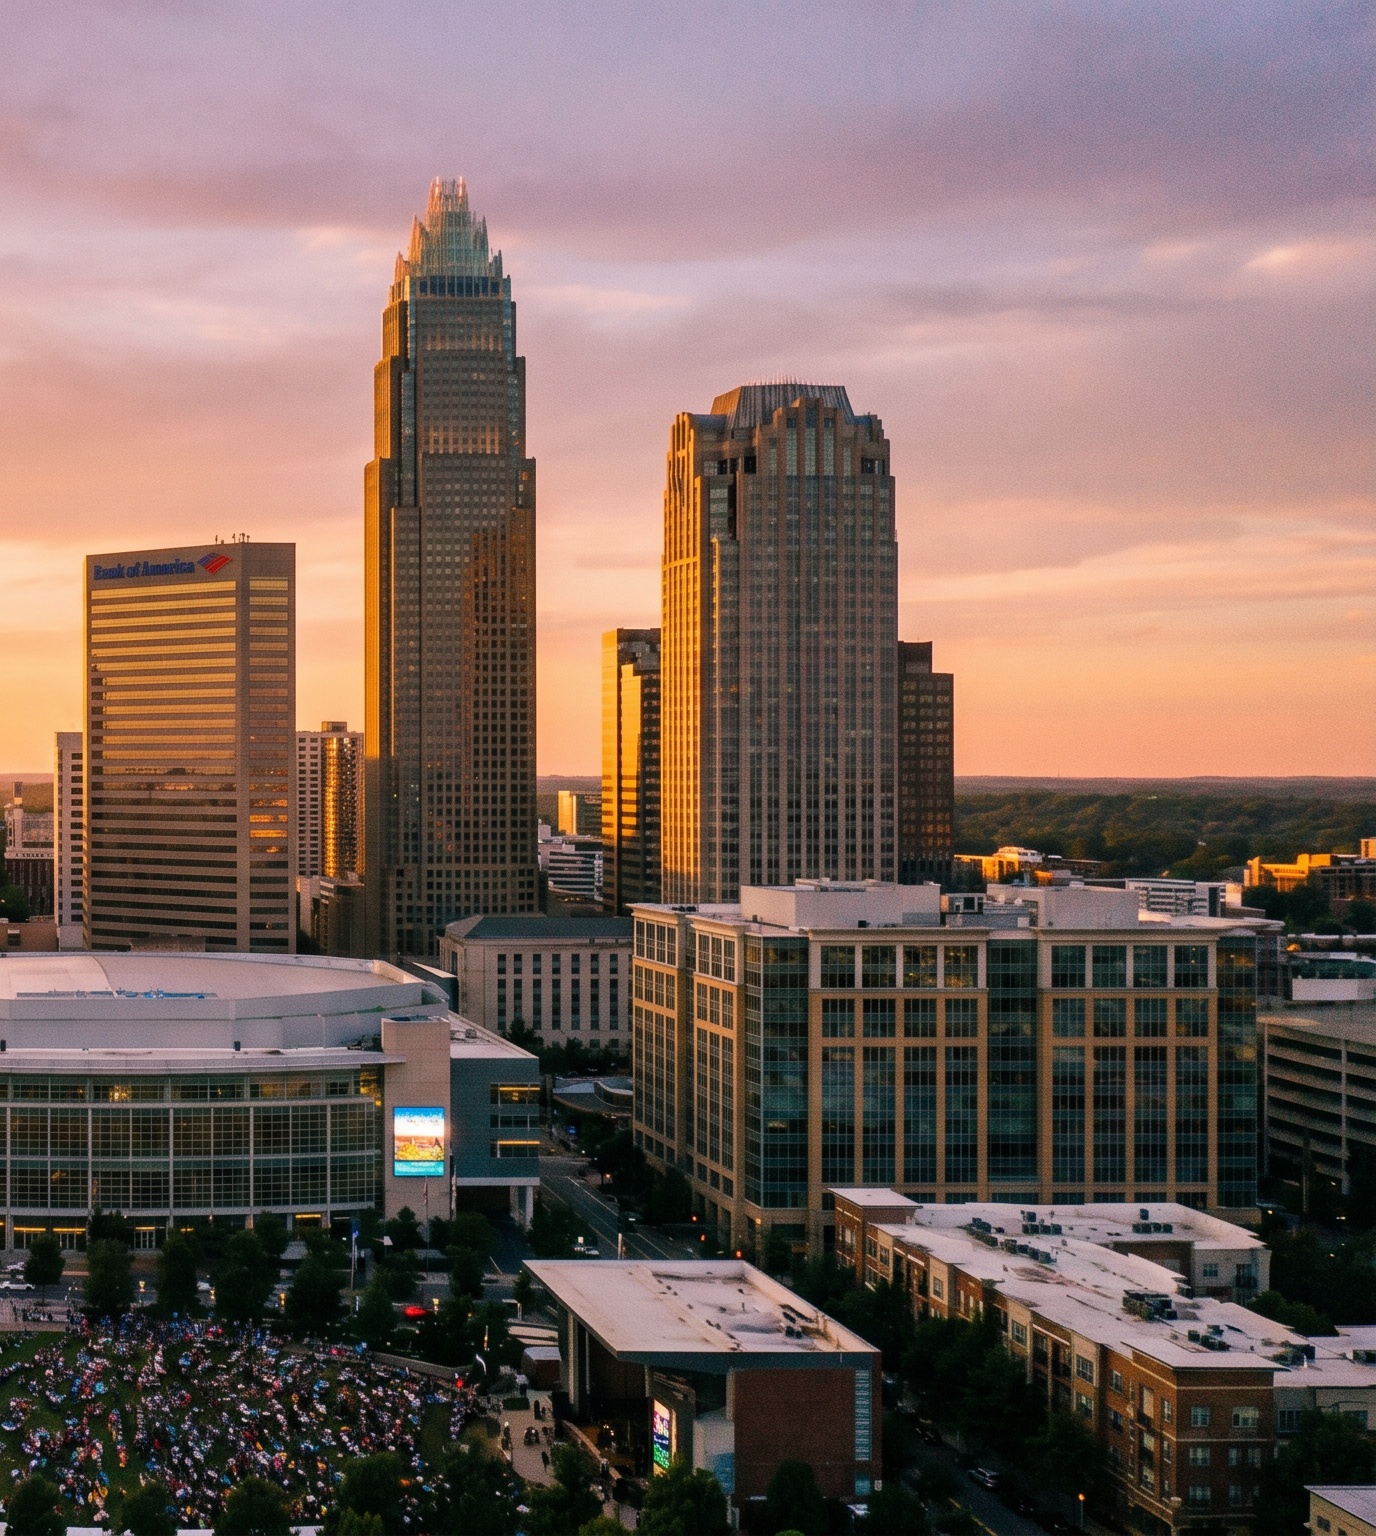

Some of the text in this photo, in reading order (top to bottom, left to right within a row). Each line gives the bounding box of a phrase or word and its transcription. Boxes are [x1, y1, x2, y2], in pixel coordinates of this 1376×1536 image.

[94, 558, 195, 580] Bank of America
